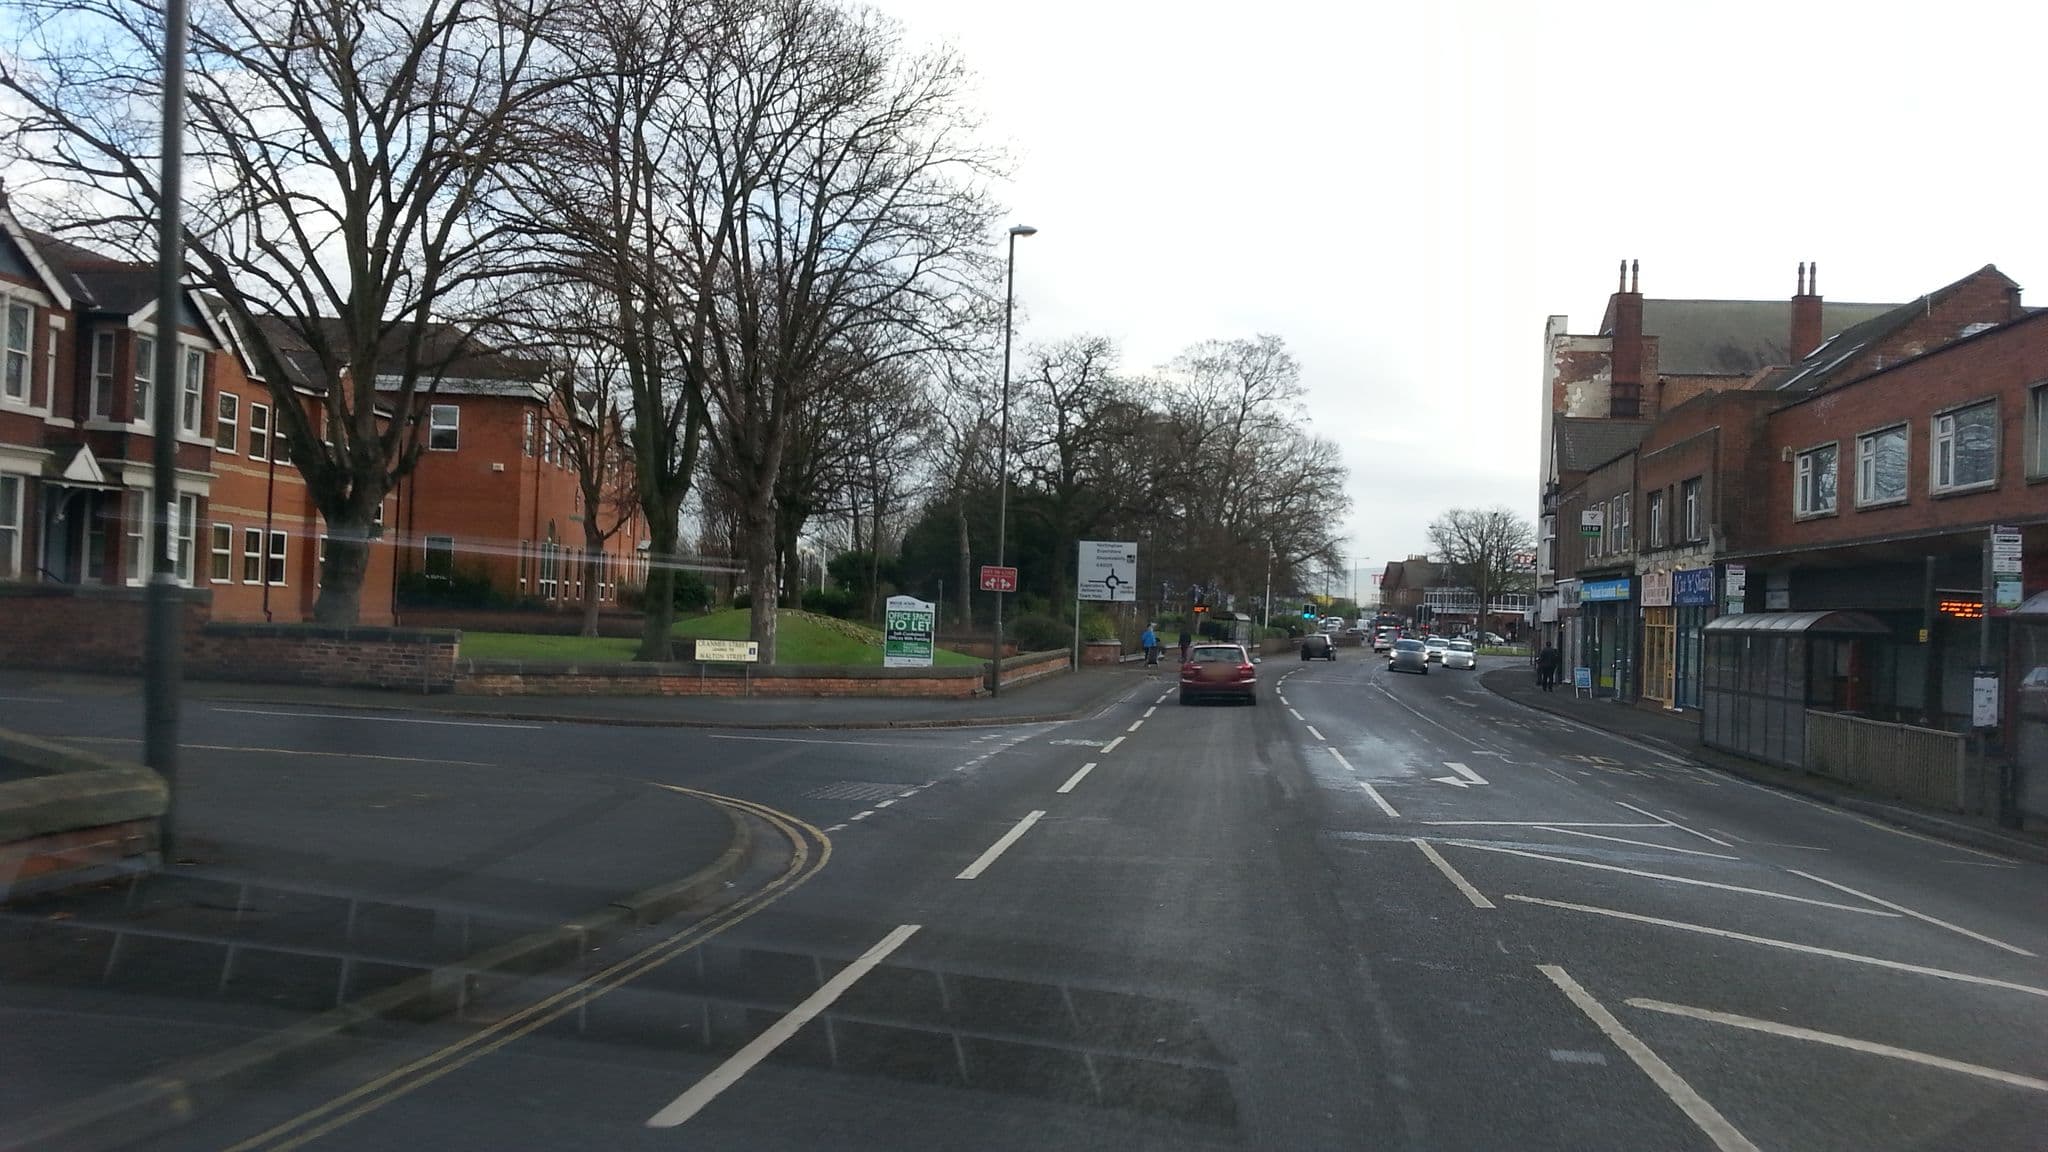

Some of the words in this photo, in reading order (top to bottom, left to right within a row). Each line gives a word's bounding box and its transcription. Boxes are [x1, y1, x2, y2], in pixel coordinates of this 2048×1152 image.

[888, 612, 911, 620] OFFICE
[912, 613, 932, 622] SPACE
[889, 620, 907, 631] TO
[911, 621, 931, 632] LET
